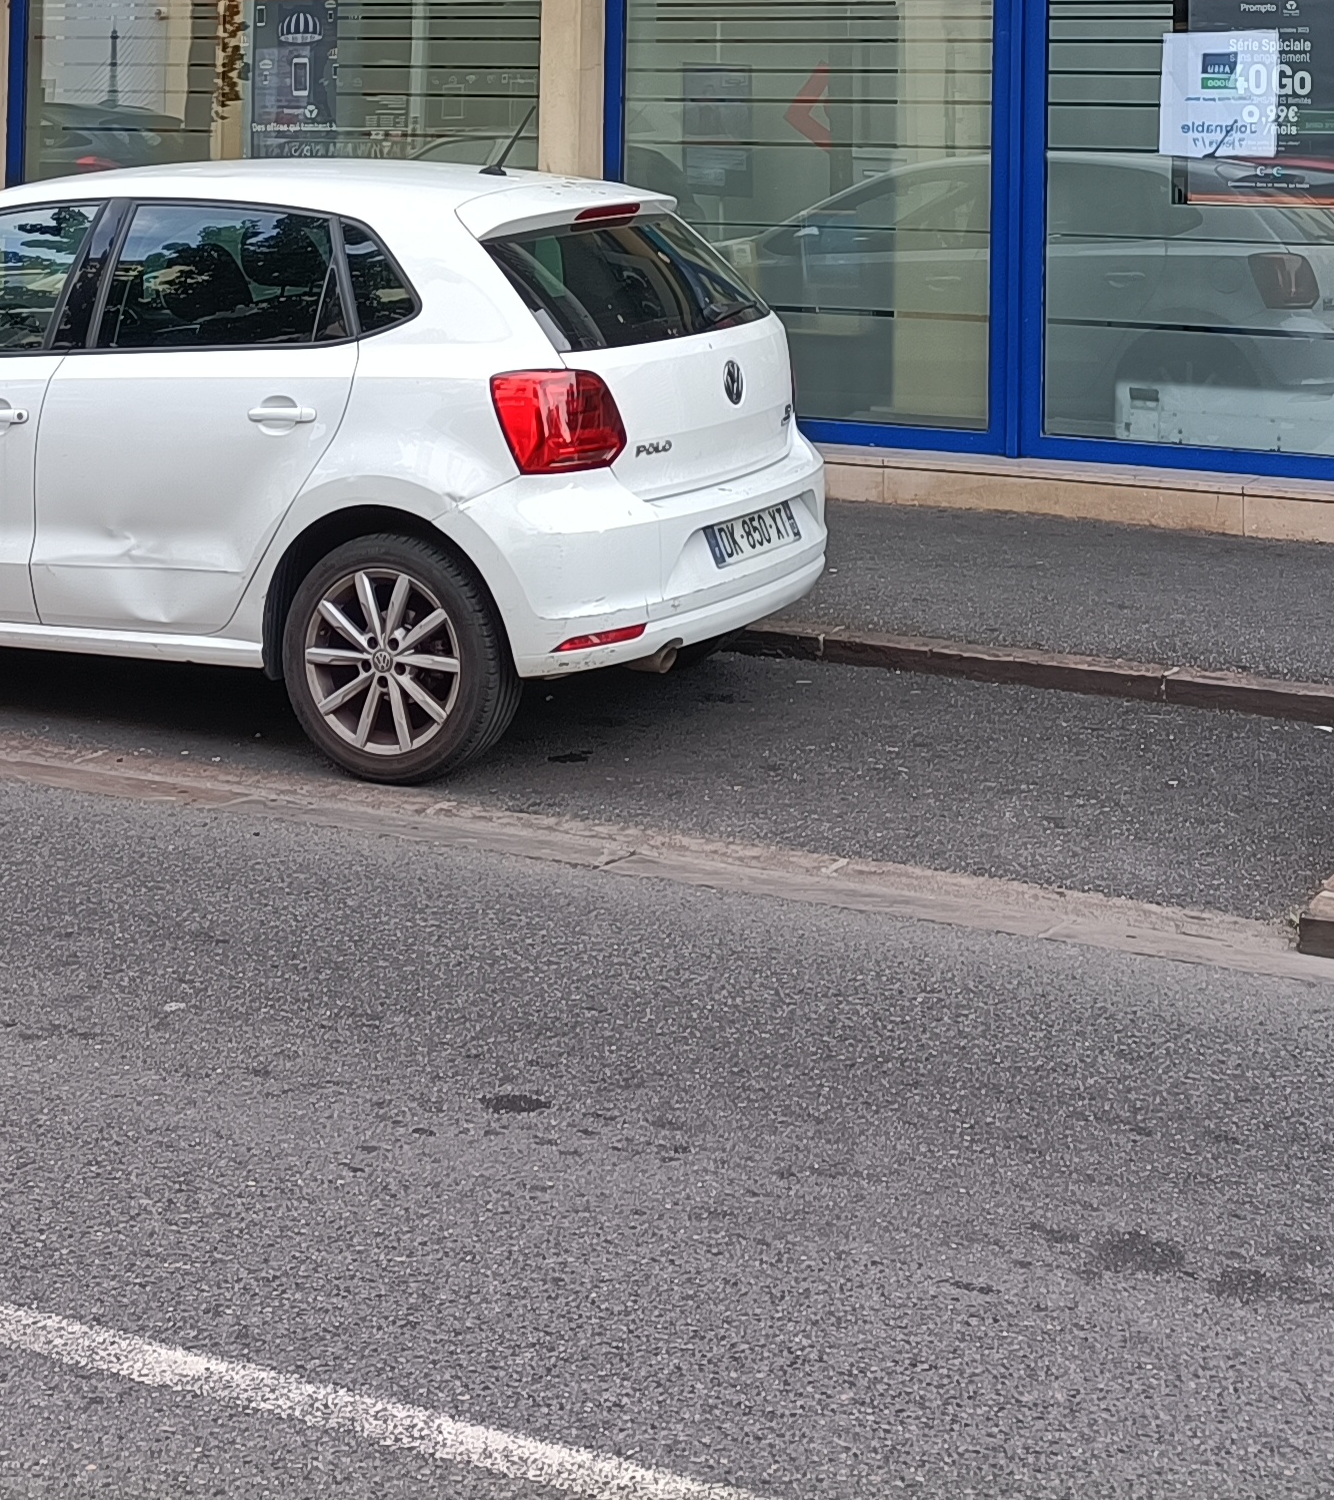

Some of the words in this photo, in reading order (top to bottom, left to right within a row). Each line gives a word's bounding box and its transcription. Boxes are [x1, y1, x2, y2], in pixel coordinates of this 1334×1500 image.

[1240, 3, 1277, 14] Prompto
[1229, 38, 1259, 51] Série
[1229, 54, 1251, 62] sns
[1272, 63, 1312, 96] Go
[1257, 166, 1282, 177] CC
[635, 439, 673, 458] POLO
[717, 507, 790, 559] DK-850-XT
